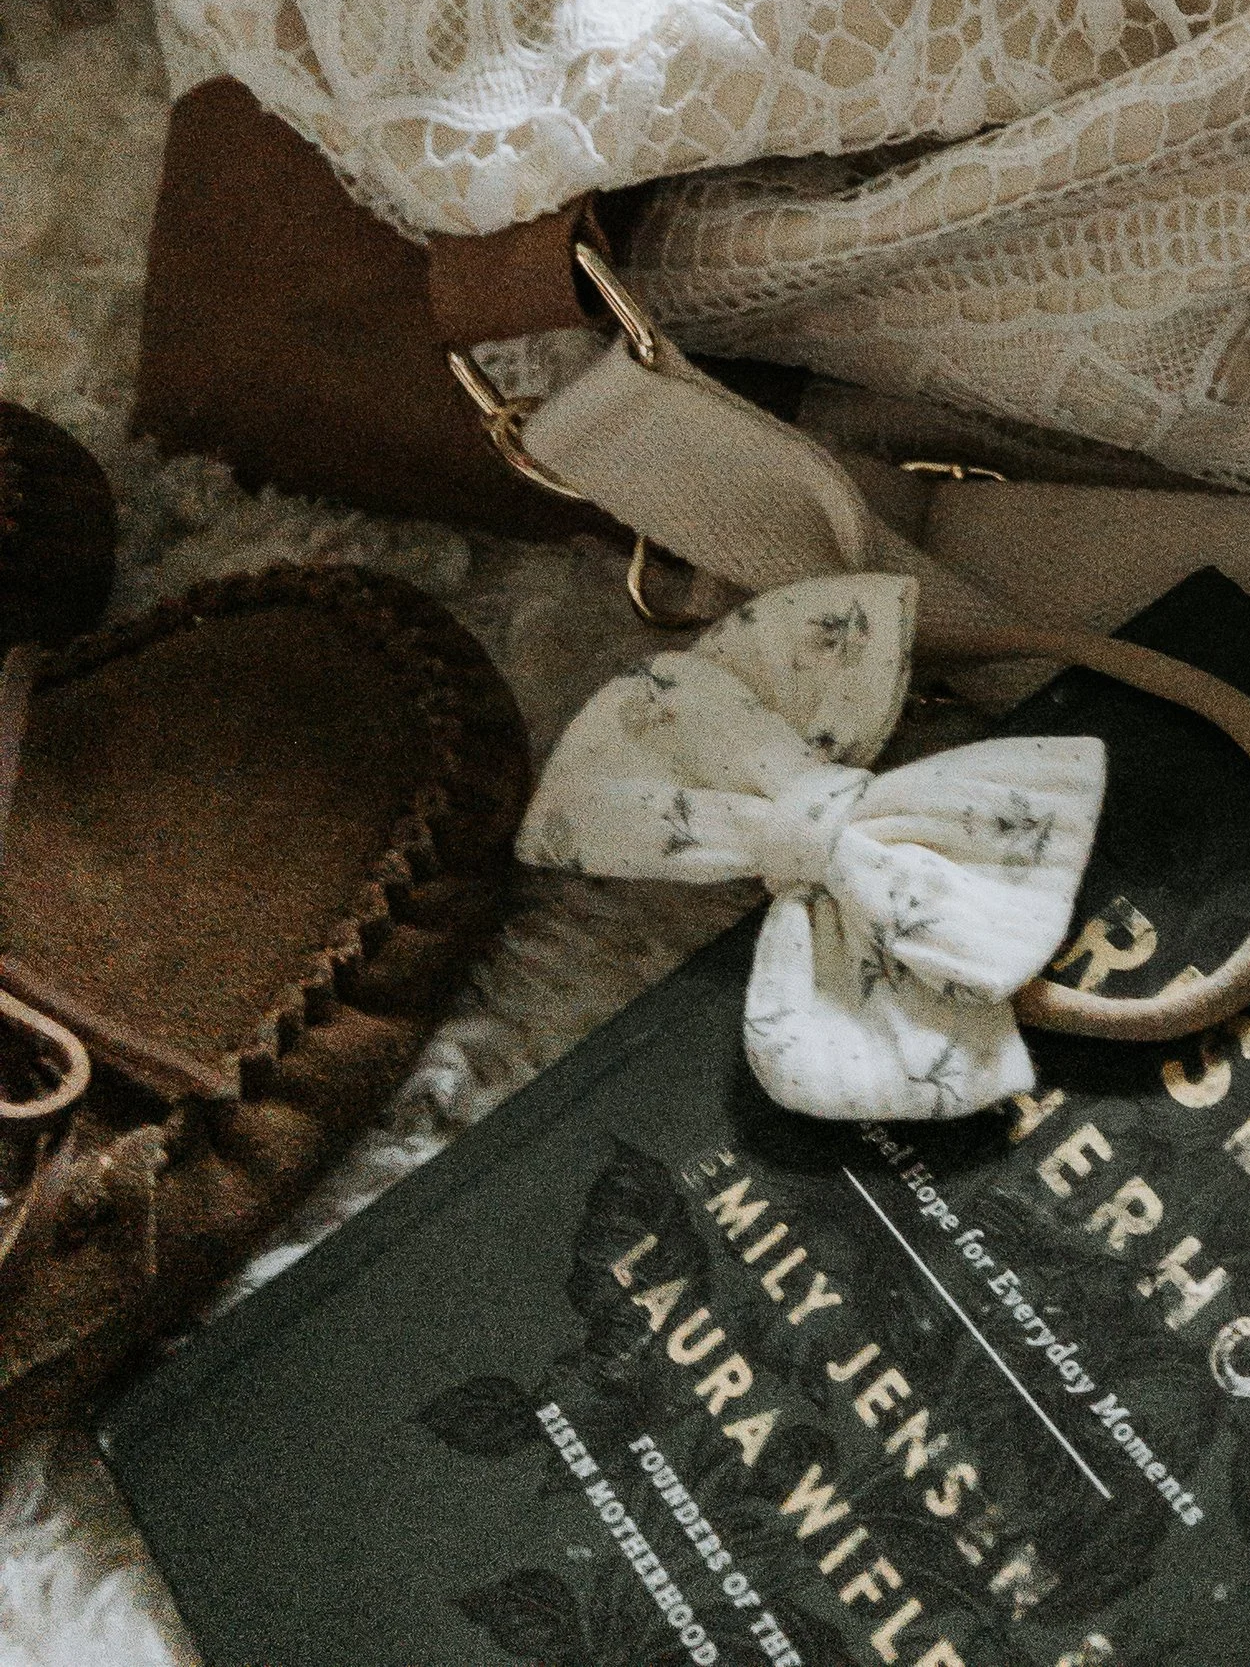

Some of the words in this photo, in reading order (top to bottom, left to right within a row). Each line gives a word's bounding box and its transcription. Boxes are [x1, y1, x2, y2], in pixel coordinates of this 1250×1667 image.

[610, 1234, 784, 1469] LAURA
[901, 1161, 960, 1232] Hope
[954, 1227, 996, 1271] for
[987, 1268, 1096, 1395] Everyday
[1090, 1392, 1204, 1527] Moments
[535, 1401, 601, 1480] RISEN
[585, 1478, 720, 1667] MOTHERHOOD
[628, 1433, 733, 1573] FOUNDERS
[722, 1572, 761, 1609] OF
